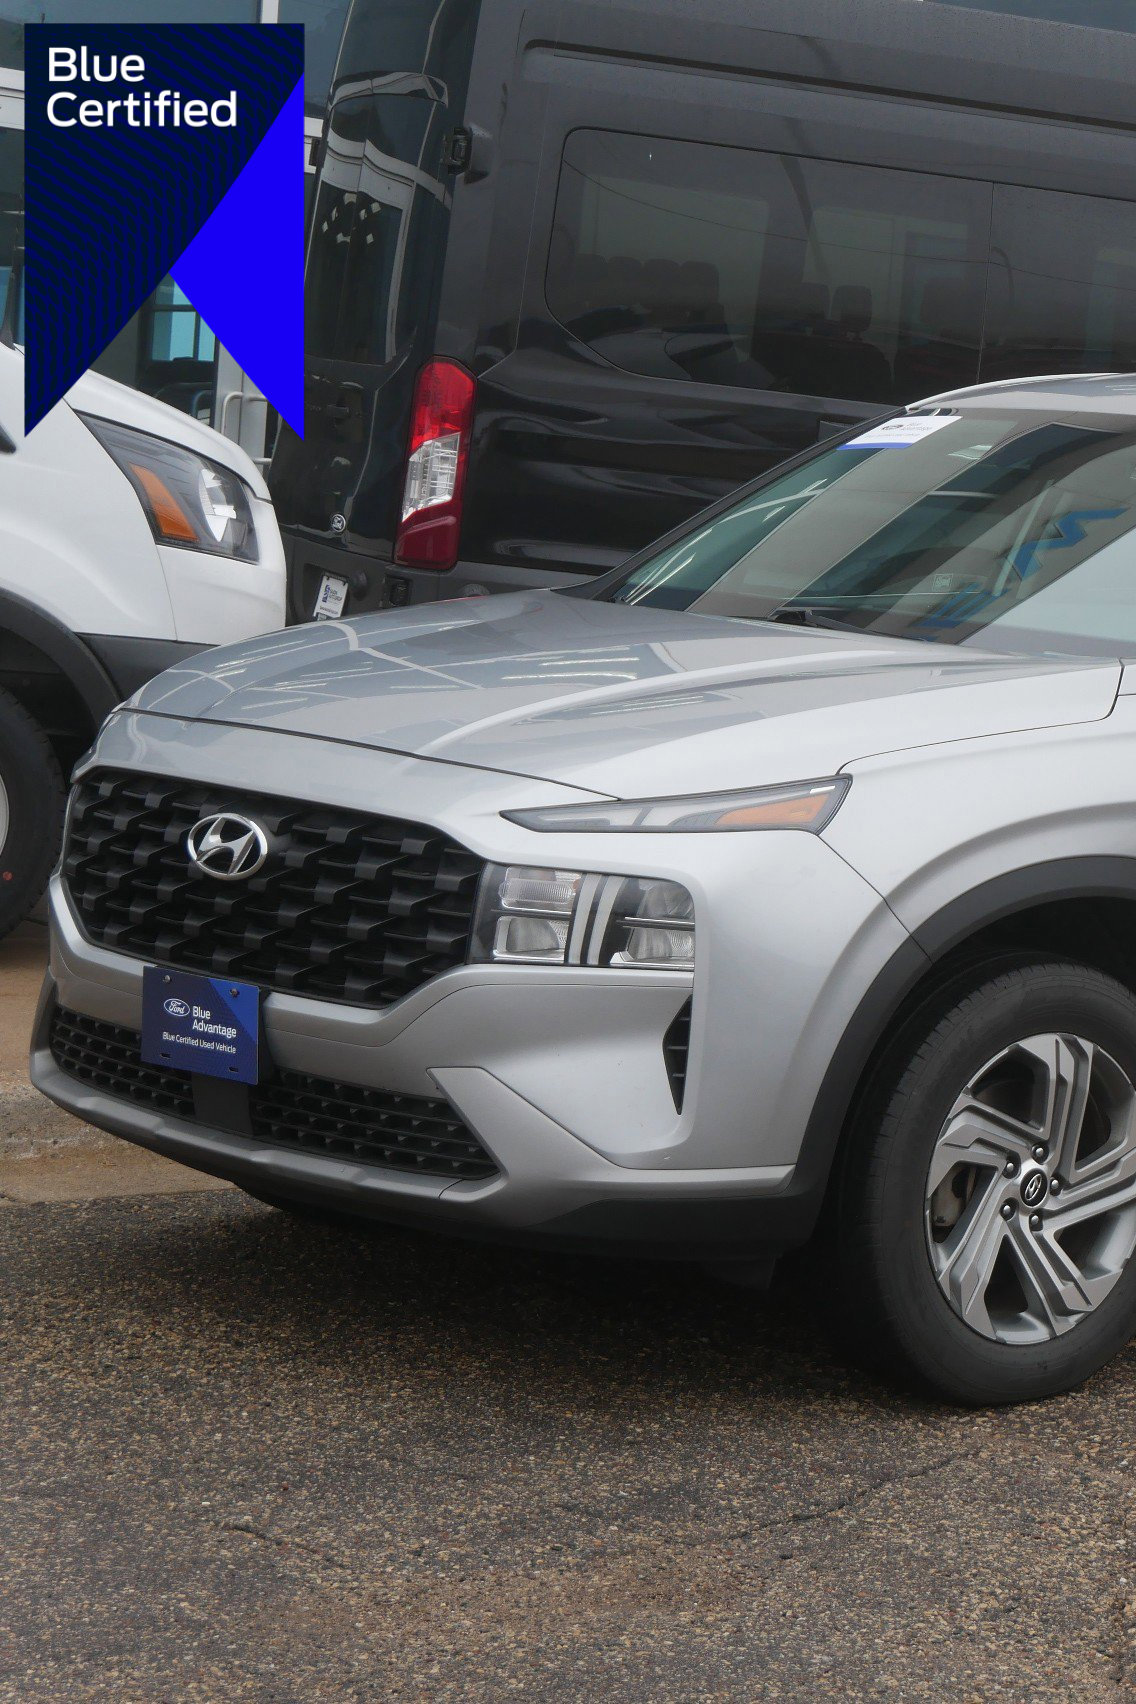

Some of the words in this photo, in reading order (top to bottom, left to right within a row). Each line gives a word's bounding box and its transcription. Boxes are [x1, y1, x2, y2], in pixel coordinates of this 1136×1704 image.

[168, 1000, 186, 1015] Ford
[192, 1006, 210, 1019] Blue
[192, 1019, 236, 1038] Advantage
[162, 1031, 175, 1041] Blue
[176, 1034, 198, 1046] Certified
[199, 1040, 214, 1049] Used
[215, 1042, 236, 1053] Vehicle
